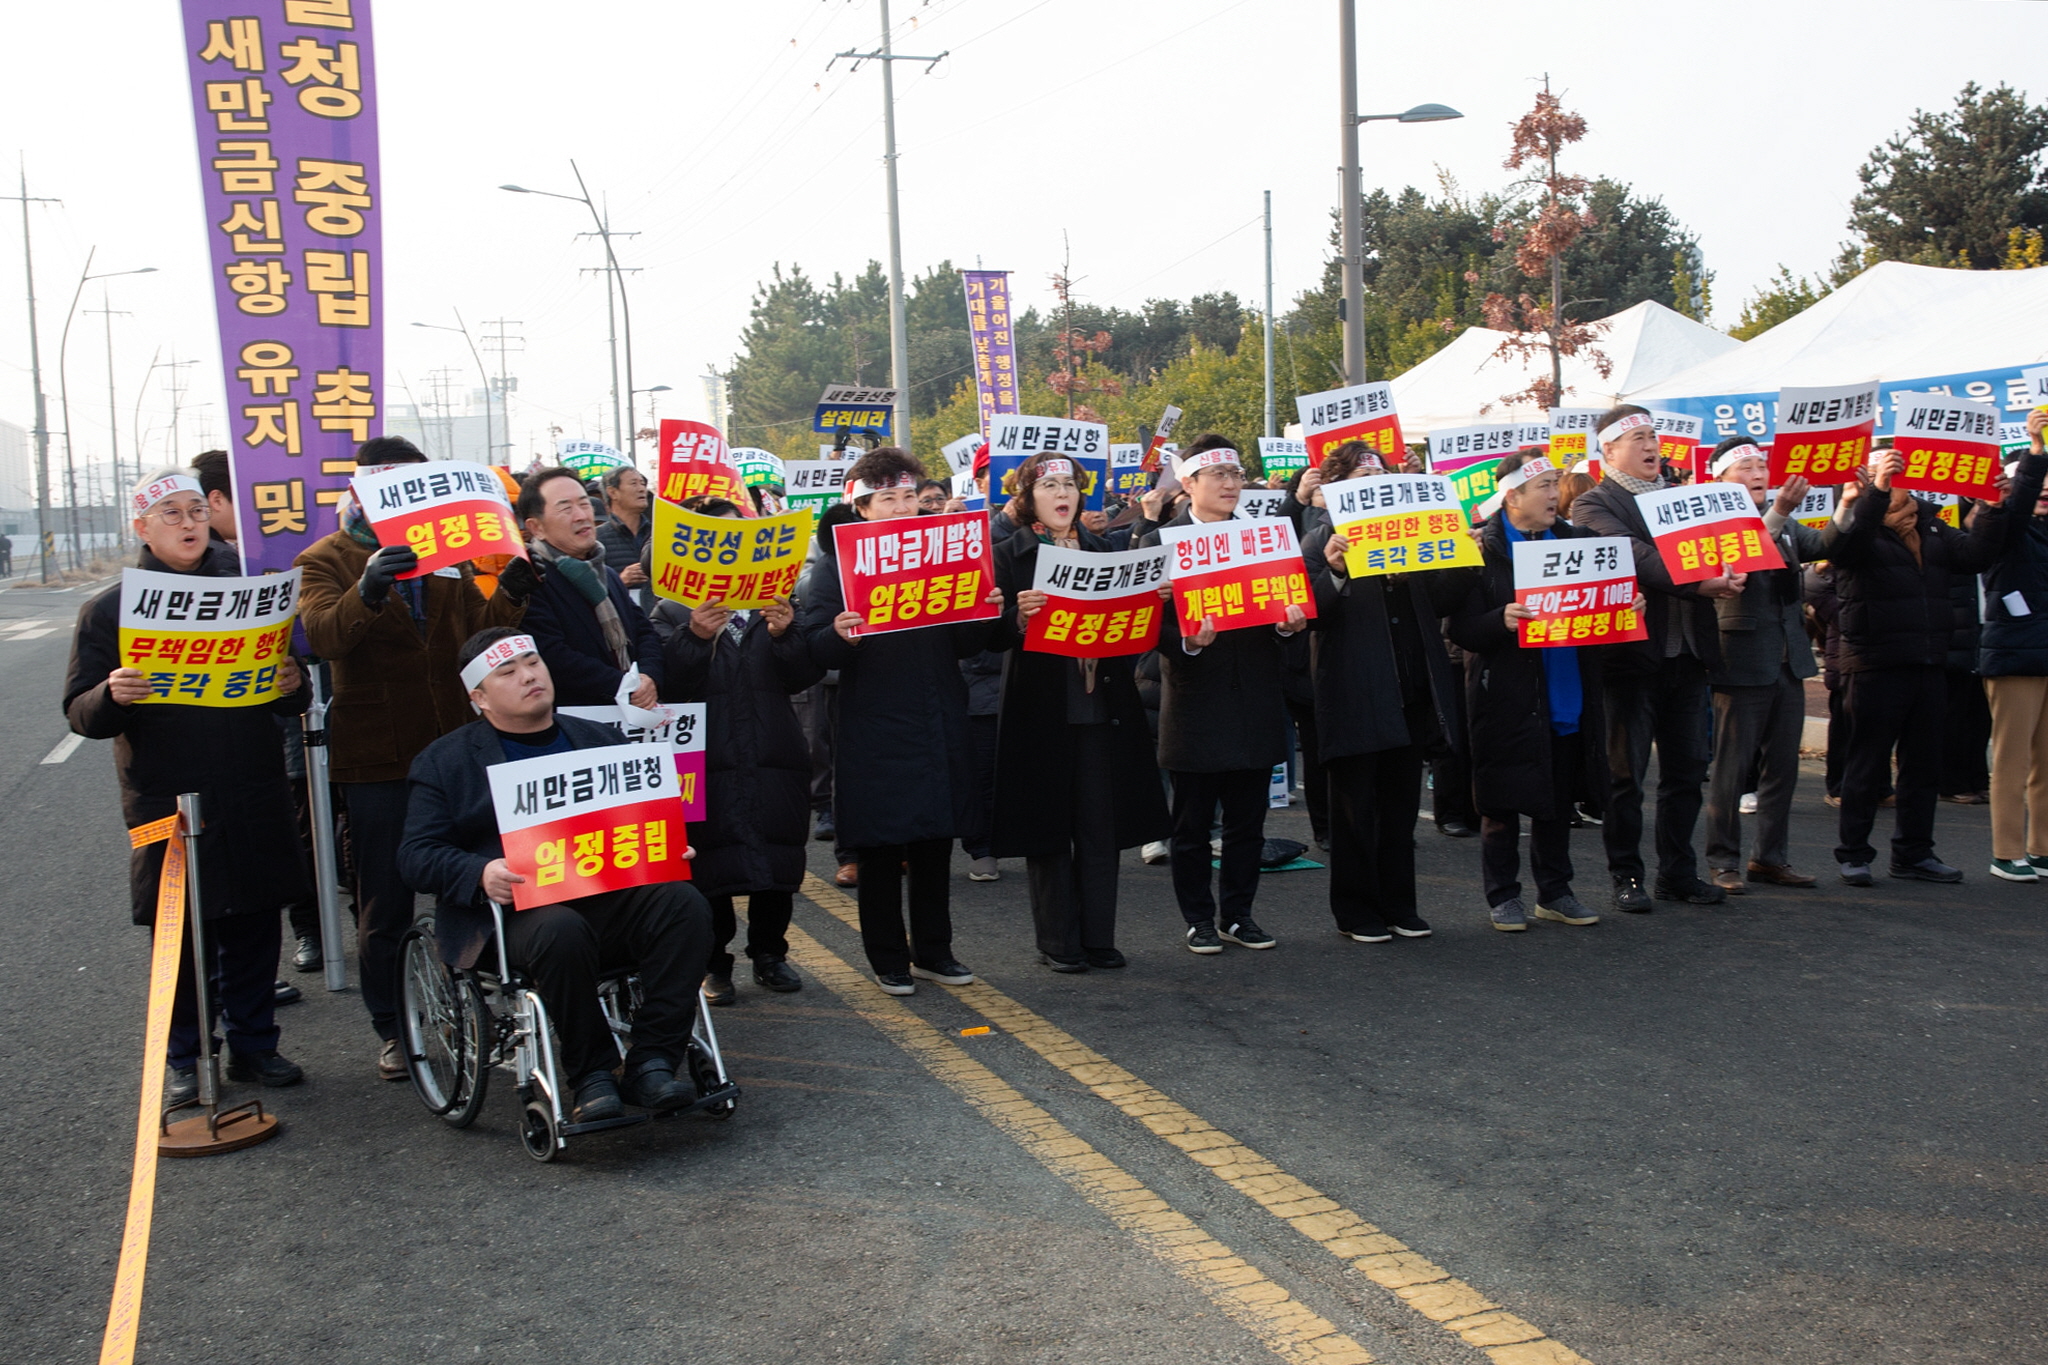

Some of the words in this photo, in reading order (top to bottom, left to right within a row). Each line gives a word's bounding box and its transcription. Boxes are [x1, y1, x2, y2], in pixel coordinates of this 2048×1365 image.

[201, 18, 292, 316] 새만금신항
[295, 158, 371, 328] 중립
[237, 341, 301, 455] 유지
[825, 390, 897, 404] 새만금신항
[1311, 389, 1389, 426] 새만금개발청
[1786, 388, 1874, 425] 새만금개발청
[820, 409, 886, 428] 살려내라
[1905, 406, 1996, 437] 새만금개발청
[996, 425, 1101, 453] 새만금신항
[1439, 429, 1514, 455] 새만금신항
[1784, 435, 1867, 474] 엄정중립
[1904, 449, 1993, 485] 엄정중립
[148, 478, 179, 499] 유지
[1339, 481, 1447, 515] 새만금개발청
[252, 480, 308, 536] 및
[1656, 490, 1748, 526] 새만금개발청
[671, 522, 744, 566] 공정성
[752, 523, 798, 563] 없는
[853, 519, 984, 577] 새만금개발청
[1176, 532, 1231, 571] 항의엔
[1240, 523, 1292, 557] 빠르게
[1347, 516, 1421, 547] 무책임한
[1428, 512, 1461, 535] 행정
[1367, 544, 1408, 570] 즉각
[1417, 538, 1456, 564] 중단
[1542, 549, 1583, 578] 군산
[1594, 545, 1618, 573] 주장
[1676, 529, 1764, 571] 엄정중립
[657, 560, 803, 603] 새만금개발청
[1046, 554, 1167, 592] 새만금개발청
[132, 577, 295, 621] 새만금개발청
[867, 569, 982, 626] 엄정중립
[1183, 582, 1245, 623] 계획엔
[1251, 573, 1309, 610] 무책임
[1525, 587, 1598, 616] 받아쓰기
[1602, 580, 1634, 606] 100점
[1043, 605, 1155, 645] 엄정중립
[1526, 612, 1611, 643] 현실행정
[1615, 608, 1638, 631] 0점
[126, 636, 247, 665] 무책임한
[253, 626, 290, 662] 행정
[485, 642, 514, 668] 신항
[147, 671, 211, 699] 즉각
[222, 663, 279, 700] 중단
[512, 755, 663, 817] 새만금개발청
[534, 819, 668, 888] 엄정중립
